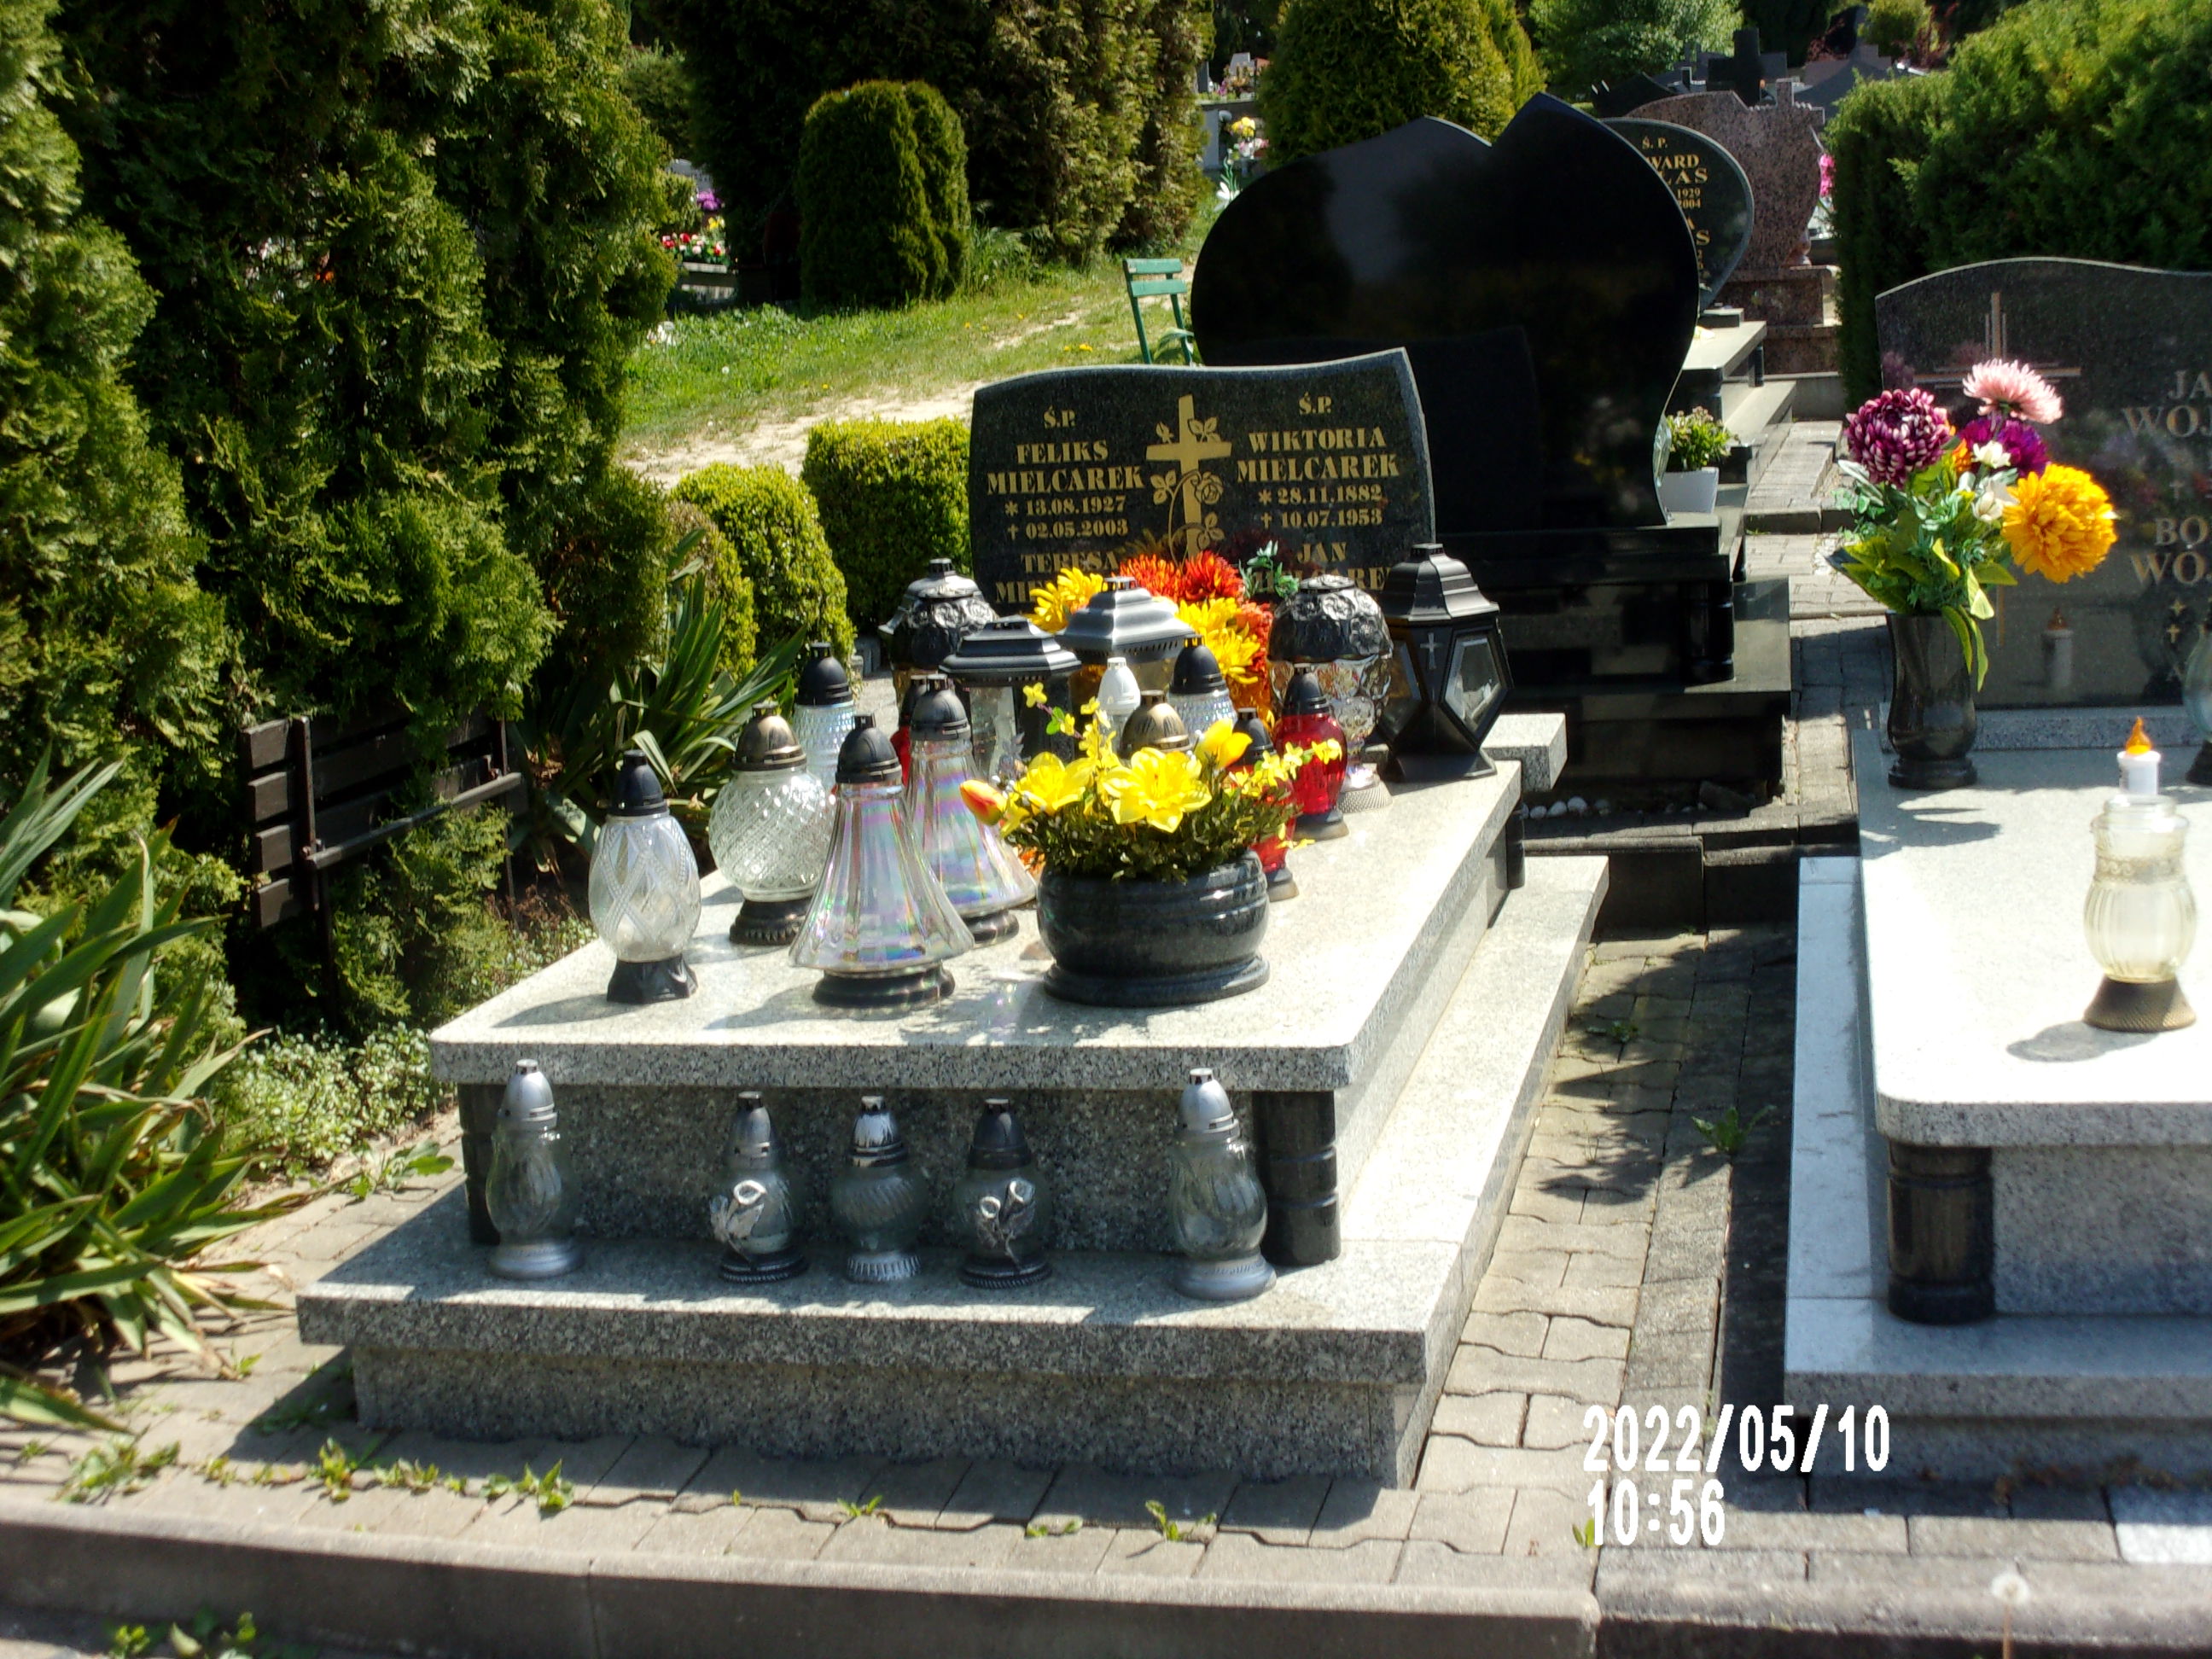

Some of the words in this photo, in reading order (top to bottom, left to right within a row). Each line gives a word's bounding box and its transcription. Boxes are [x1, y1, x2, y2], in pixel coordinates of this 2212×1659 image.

[1016, 439, 1109, 464] FELIKS
[1249, 427, 1387, 453] WIKTORIA
[1237, 453, 1400, 483] MIELCAREK
[987, 466, 1145, 495] MIELCAREK
[1026, 495, 1126, 516] 13.08.1927
[1278, 484, 1382, 505] 28.11.1882
[1026, 519, 1128, 539] 02.05.2003
[1282, 508, 1382, 528] 10.07.1953
[1021, 550, 1119, 574] TERESA
[1297, 541, 1348, 563] JAN
[2130, 551, 2212, 585] WO
